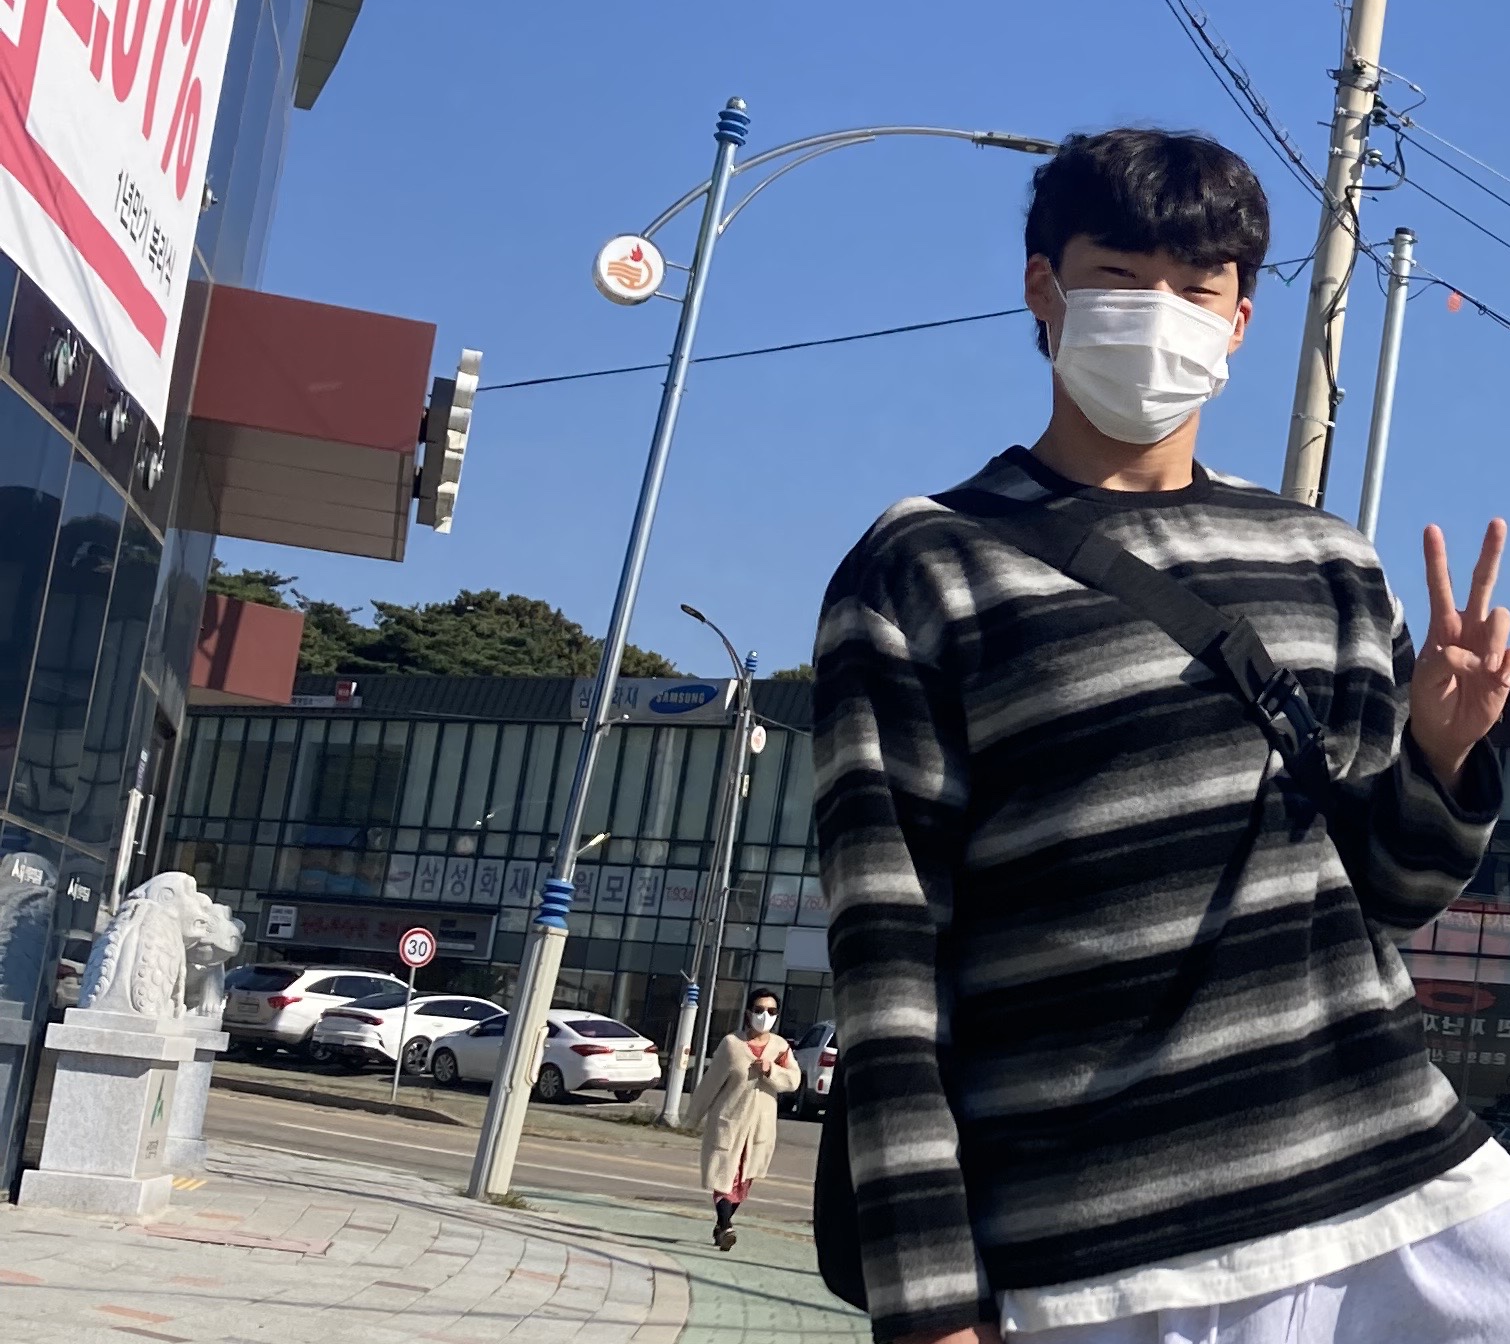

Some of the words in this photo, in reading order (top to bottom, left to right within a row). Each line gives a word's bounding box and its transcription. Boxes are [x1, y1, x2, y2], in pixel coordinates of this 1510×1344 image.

[114, 168, 151, 258] 1년만기
[578, 685, 640, 710] 삼화재
[655, 691, 705, 705] SAMSUNG
[418, 861, 530, 900] 삼성화재
[407, 939, 428, 957] 30
